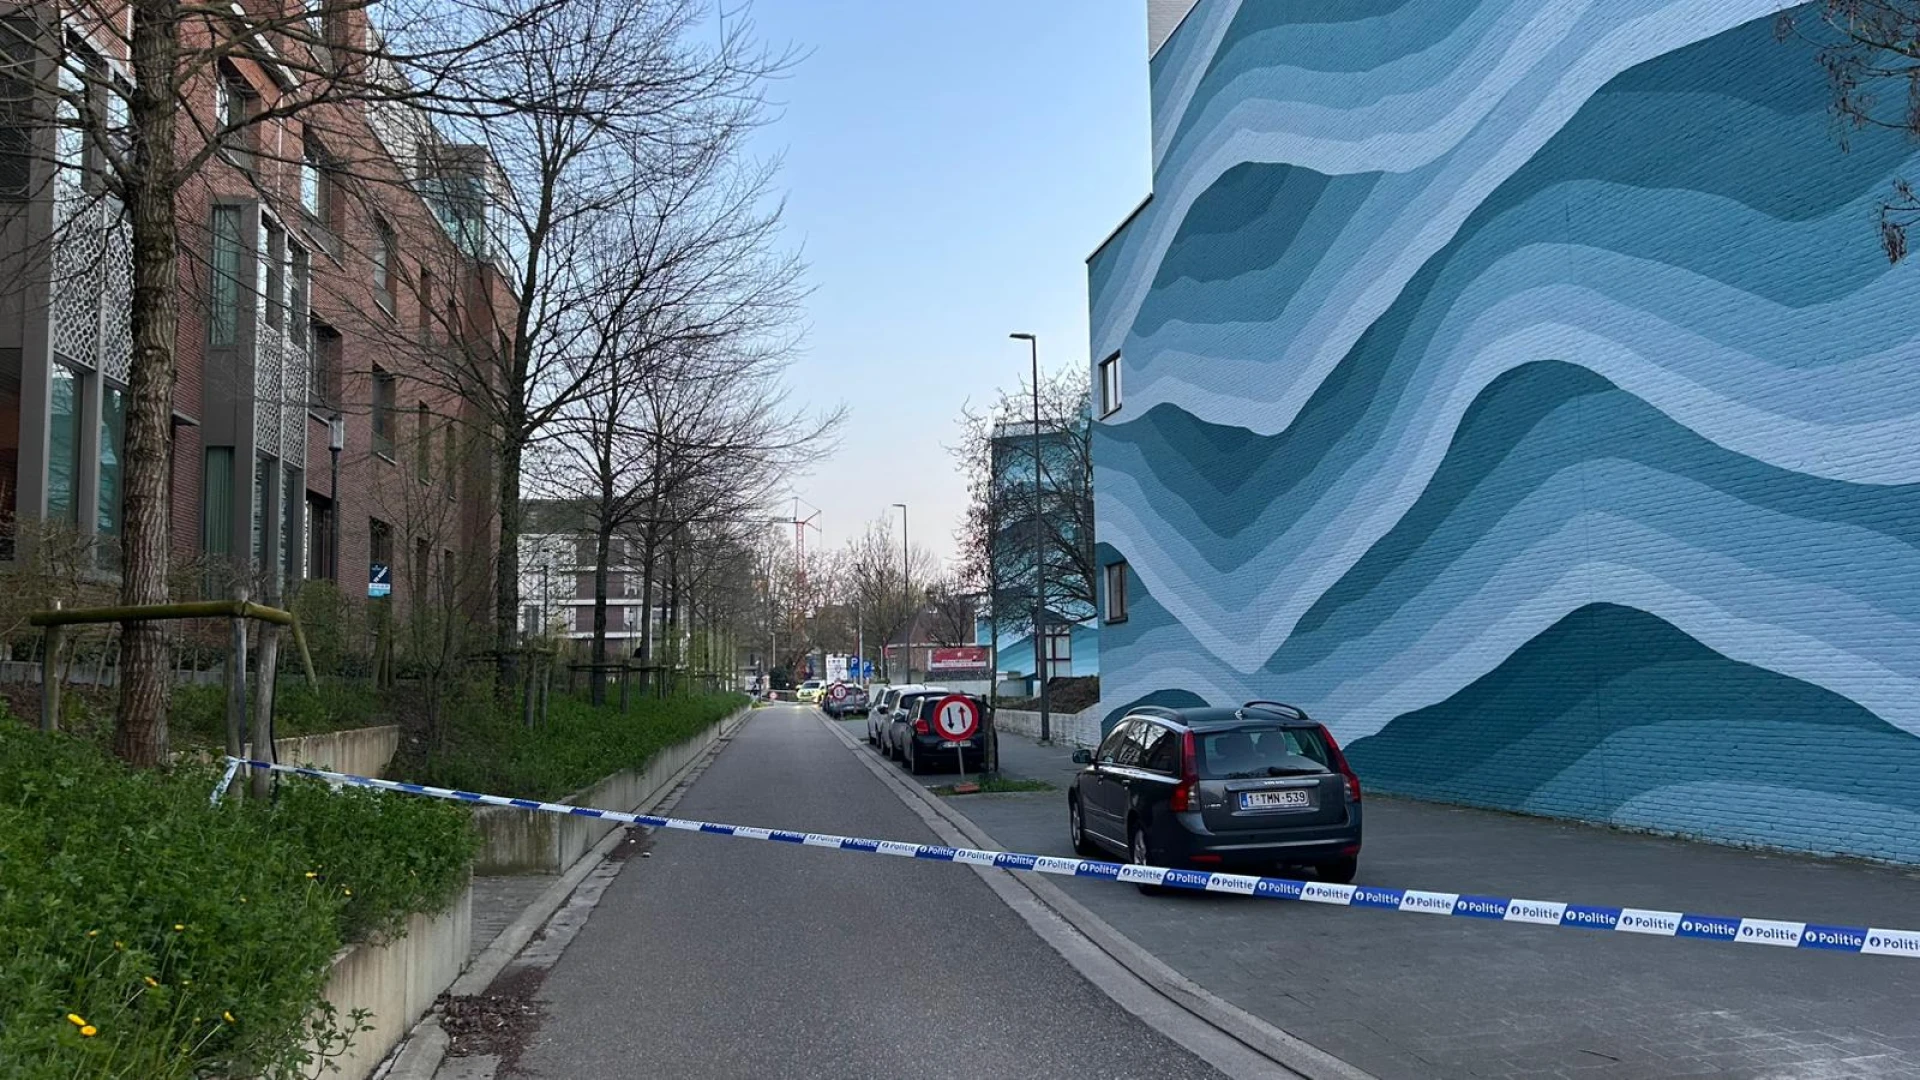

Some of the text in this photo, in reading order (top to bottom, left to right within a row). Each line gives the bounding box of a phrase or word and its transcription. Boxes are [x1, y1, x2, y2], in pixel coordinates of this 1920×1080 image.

[851, 657, 859, 667] P
[863, 661, 870, 671] P
[852, 838, 878, 848] Politie
[890, 843, 916, 853] Politie
[928, 847, 954, 857] Politie
[967, 851, 994, 860] Politie
[1006, 855, 1034, 866] Politie
[1047, 859, 1075, 871] Politie
[1089, 863, 1118, 876] Politie
[1131, 868, 1162, 881] Politie
[1176, 873, 1207, 886] Politie
[1221, 877, 1253, 891] Politie
[1268, 882, 1301, 896] Politie
[1316, 887, 1350, 900] Politie
[1365, 891, 1401, 905] Politie
[1416, 896, 1452, 910] Politie
[1468, 901, 1505, 915] Politie
[1522, 906, 1560, 920] Politie
[1578, 911, 1616, 926] Politie
[1635, 916, 1676, 931] Politie
[1694, 922, 1736, 936] Politie
[1756, 927, 1798, 941] Politie
[1818, 932, 1863, 947] Politie
[1883, 937, 1920, 951] Politi
